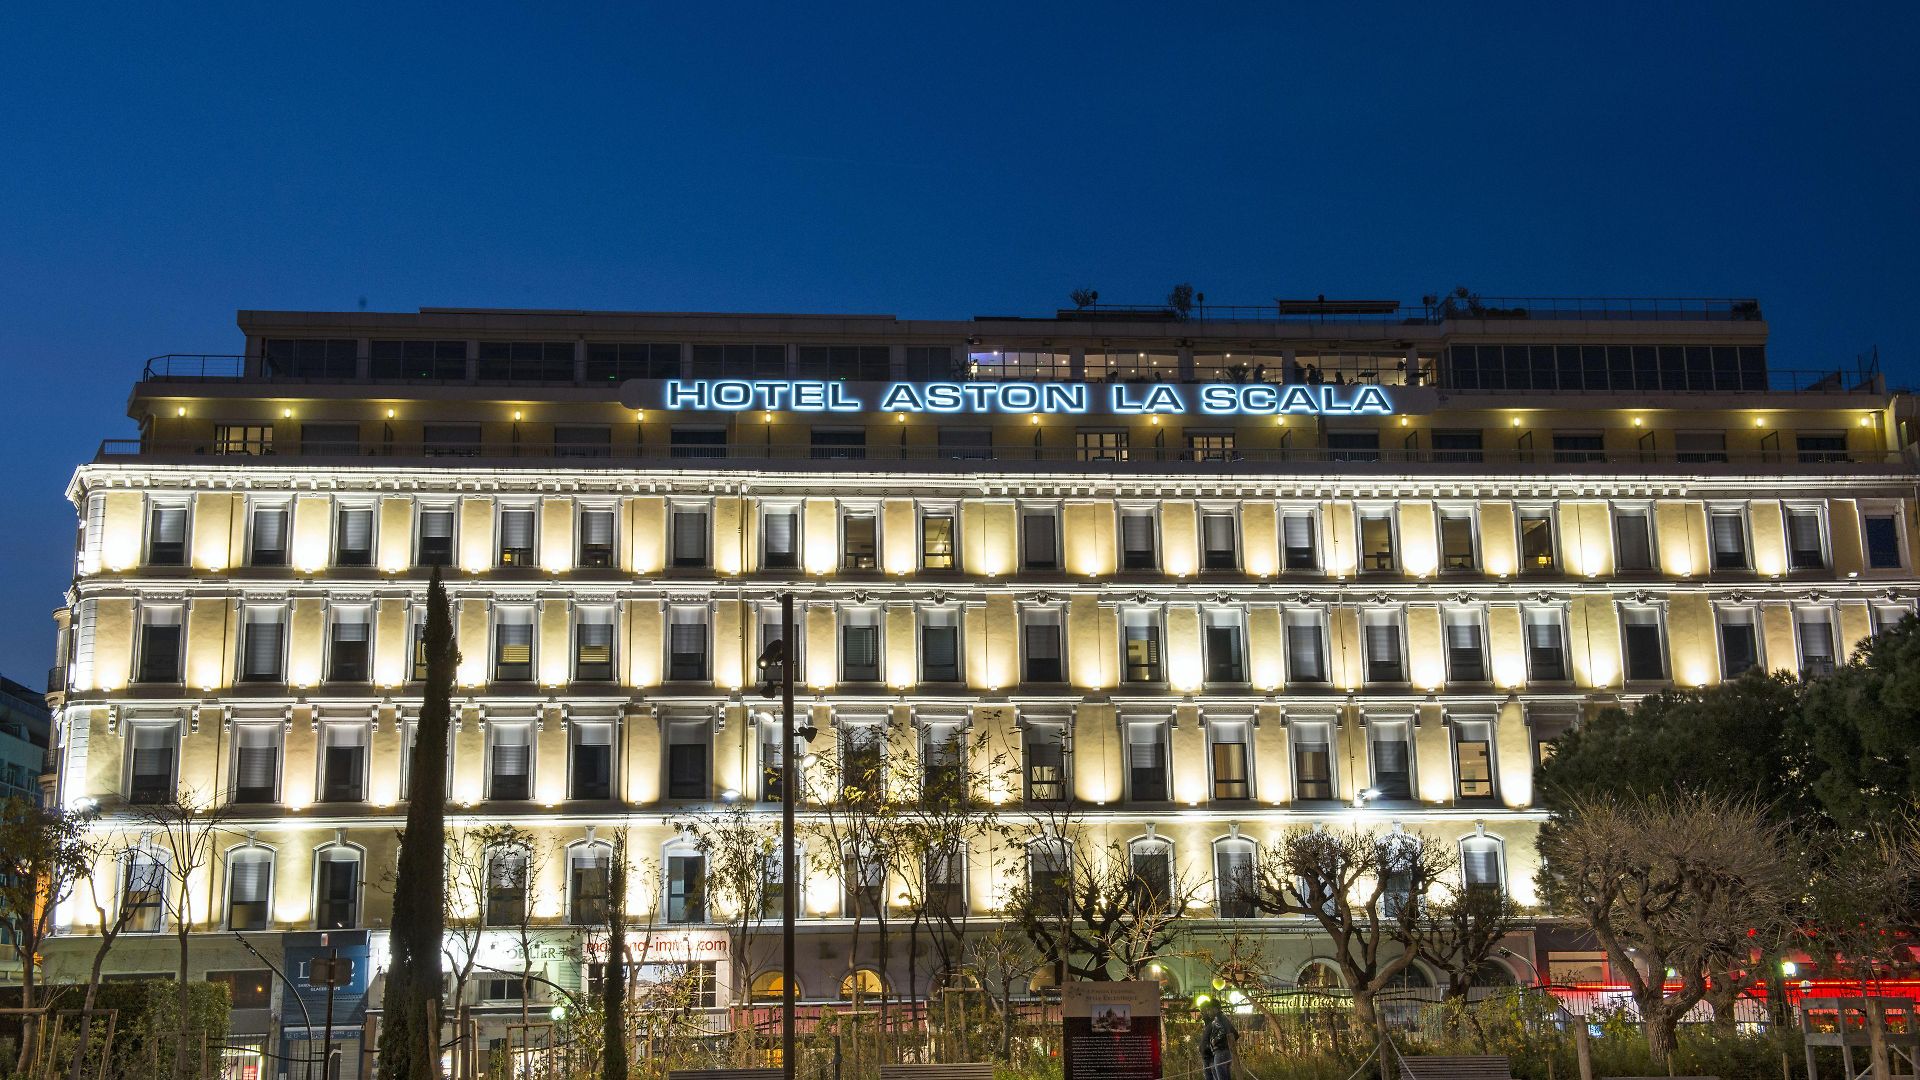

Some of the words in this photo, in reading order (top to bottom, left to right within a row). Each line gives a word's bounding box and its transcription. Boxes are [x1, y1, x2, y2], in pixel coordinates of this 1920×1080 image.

[667, 380, 860, 410] HOTEL
[882, 382, 1086, 411] ASTON
[1113, 385, 1185, 412] LA
[1202, 386, 1393, 413] SCALA
